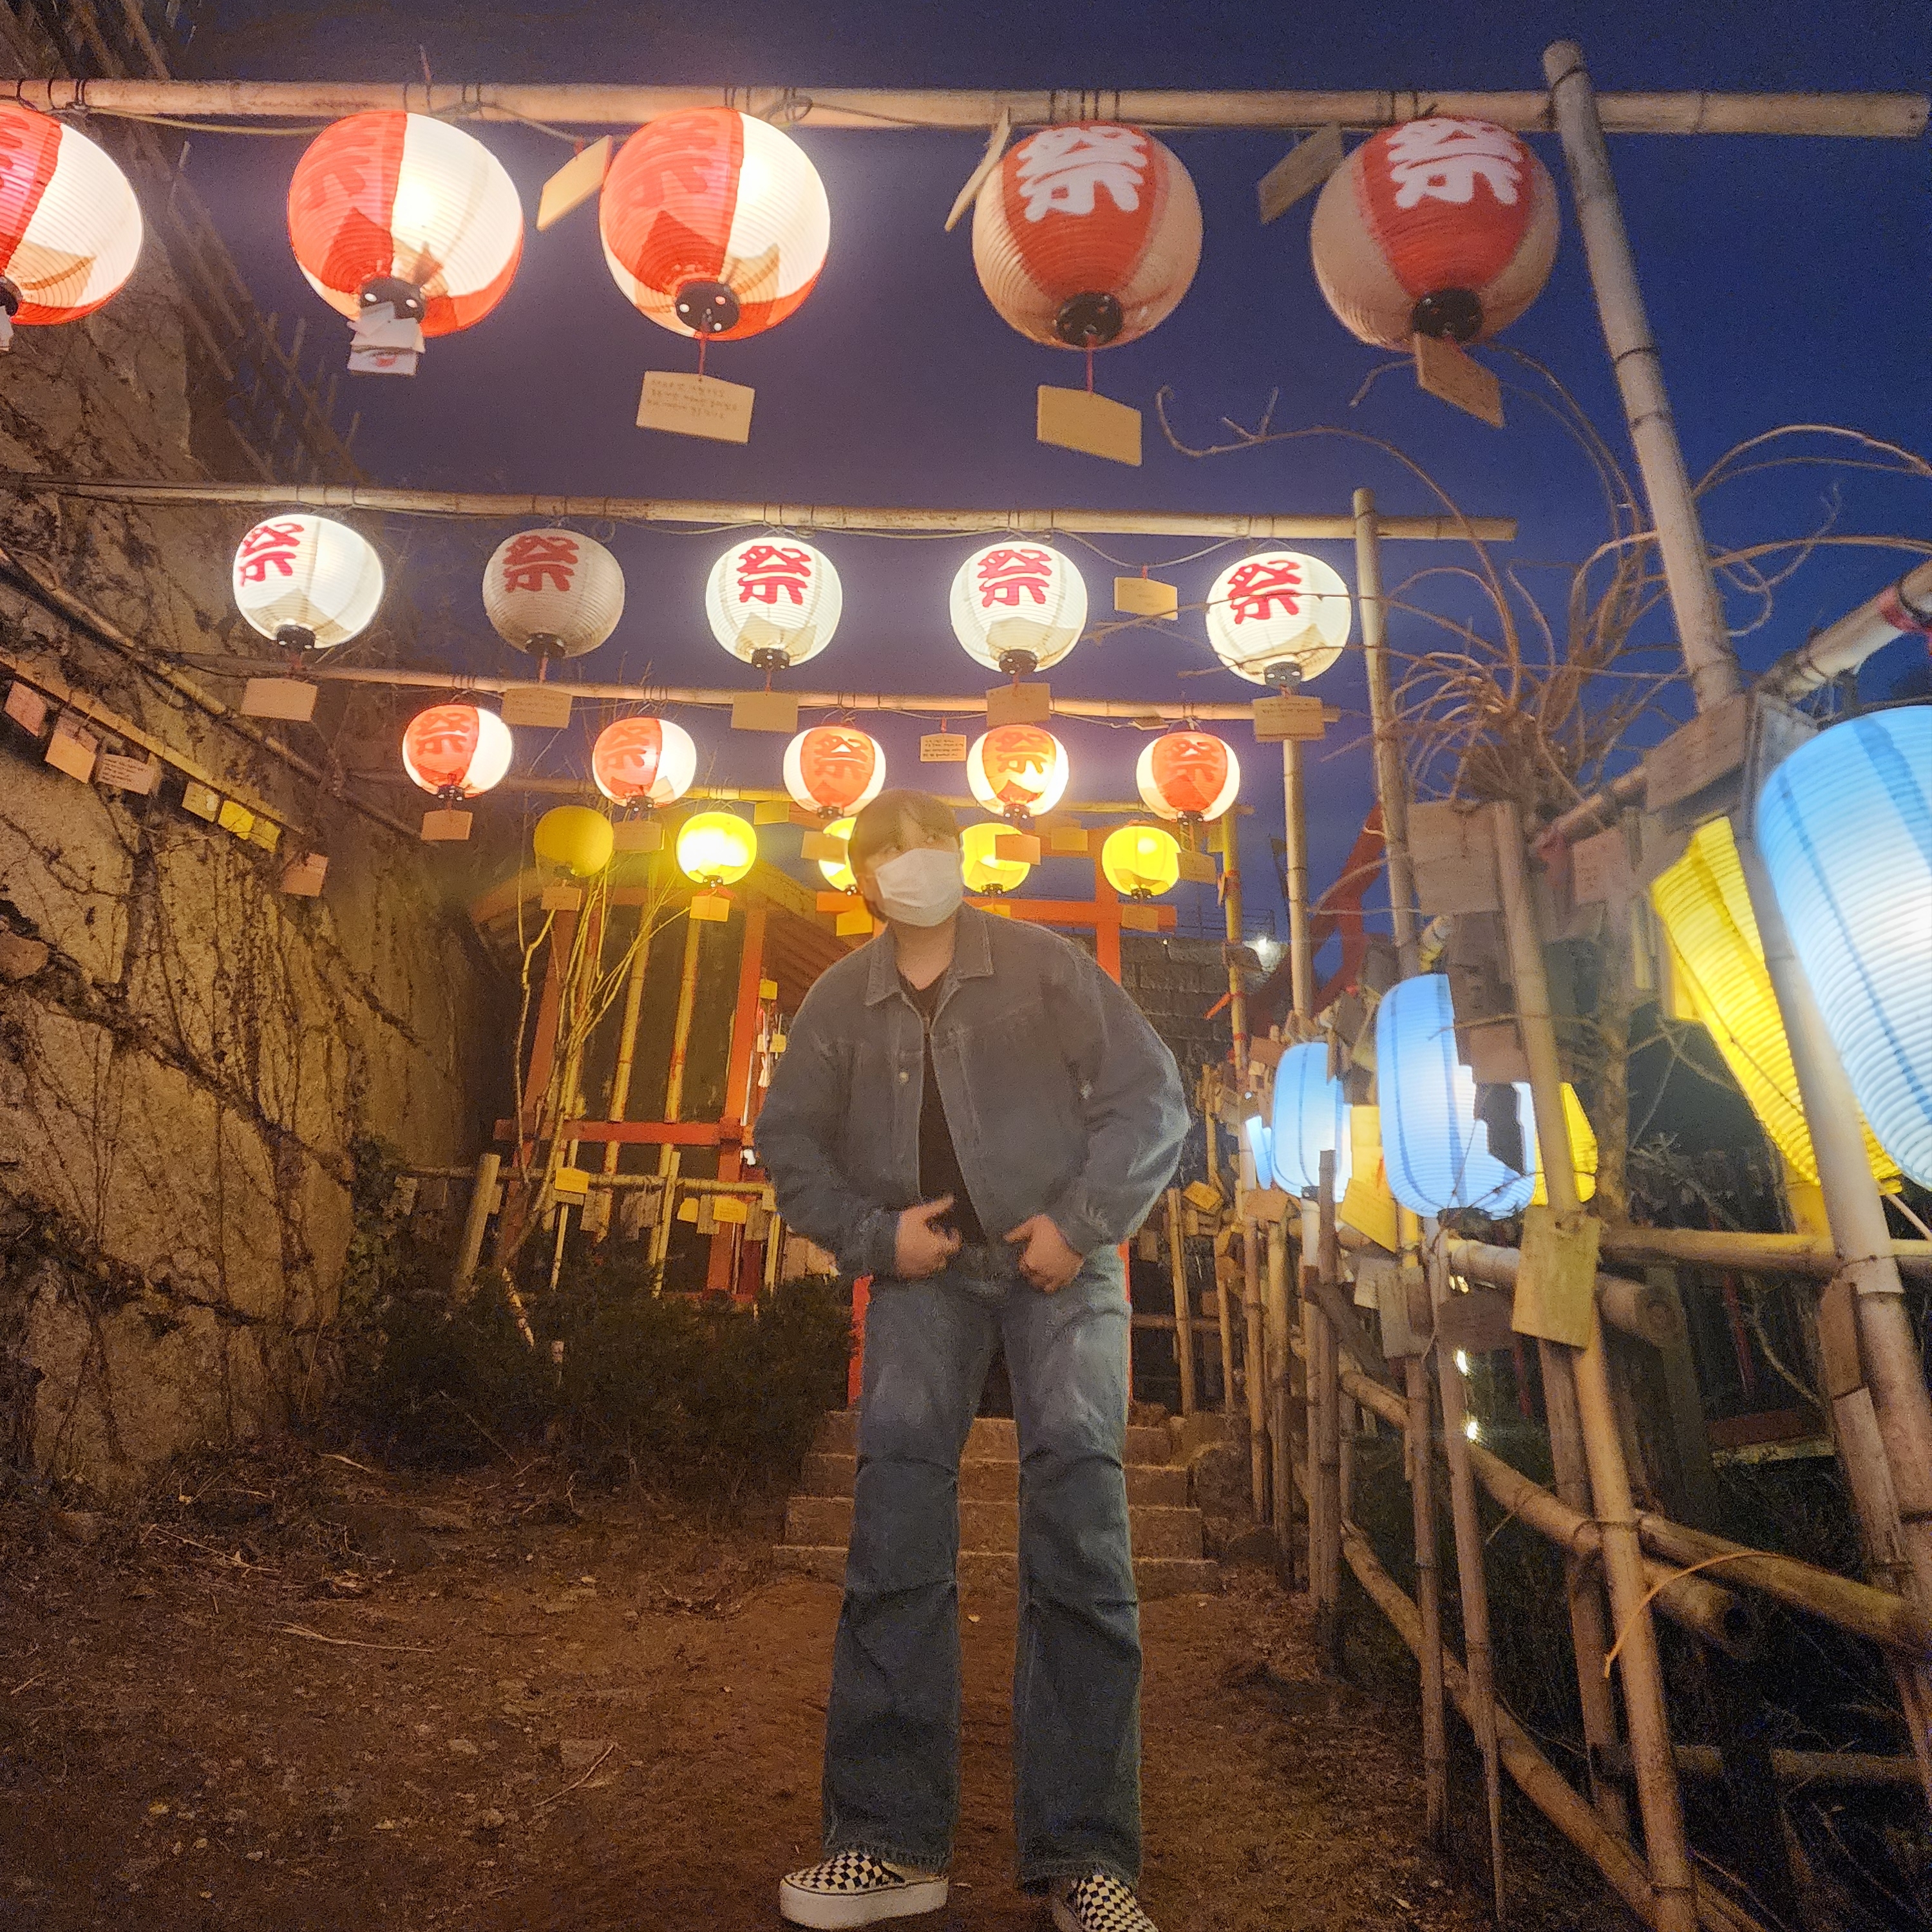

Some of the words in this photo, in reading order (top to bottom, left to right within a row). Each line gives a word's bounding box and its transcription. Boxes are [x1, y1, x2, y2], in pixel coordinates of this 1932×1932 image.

[617, 115, 719, 207] 祭
[1016, 126, 1147, 223] 祭
[1385, 118, 1522, 209] 祭
[239, 522, 304, 586] 祭
[503, 535, 578, 592] 祭
[737, 545, 811, 605] 祭
[977, 549, 1051, 607] 祭
[1227, 560, 1301, 625] 祭
[416, 712, 468, 754] 祭
[601, 725, 651, 772] 祭
[815, 732, 867, 778] 祭
[998, 728, 1049, 773] 祭
[1168, 738, 1218, 784] 祭
